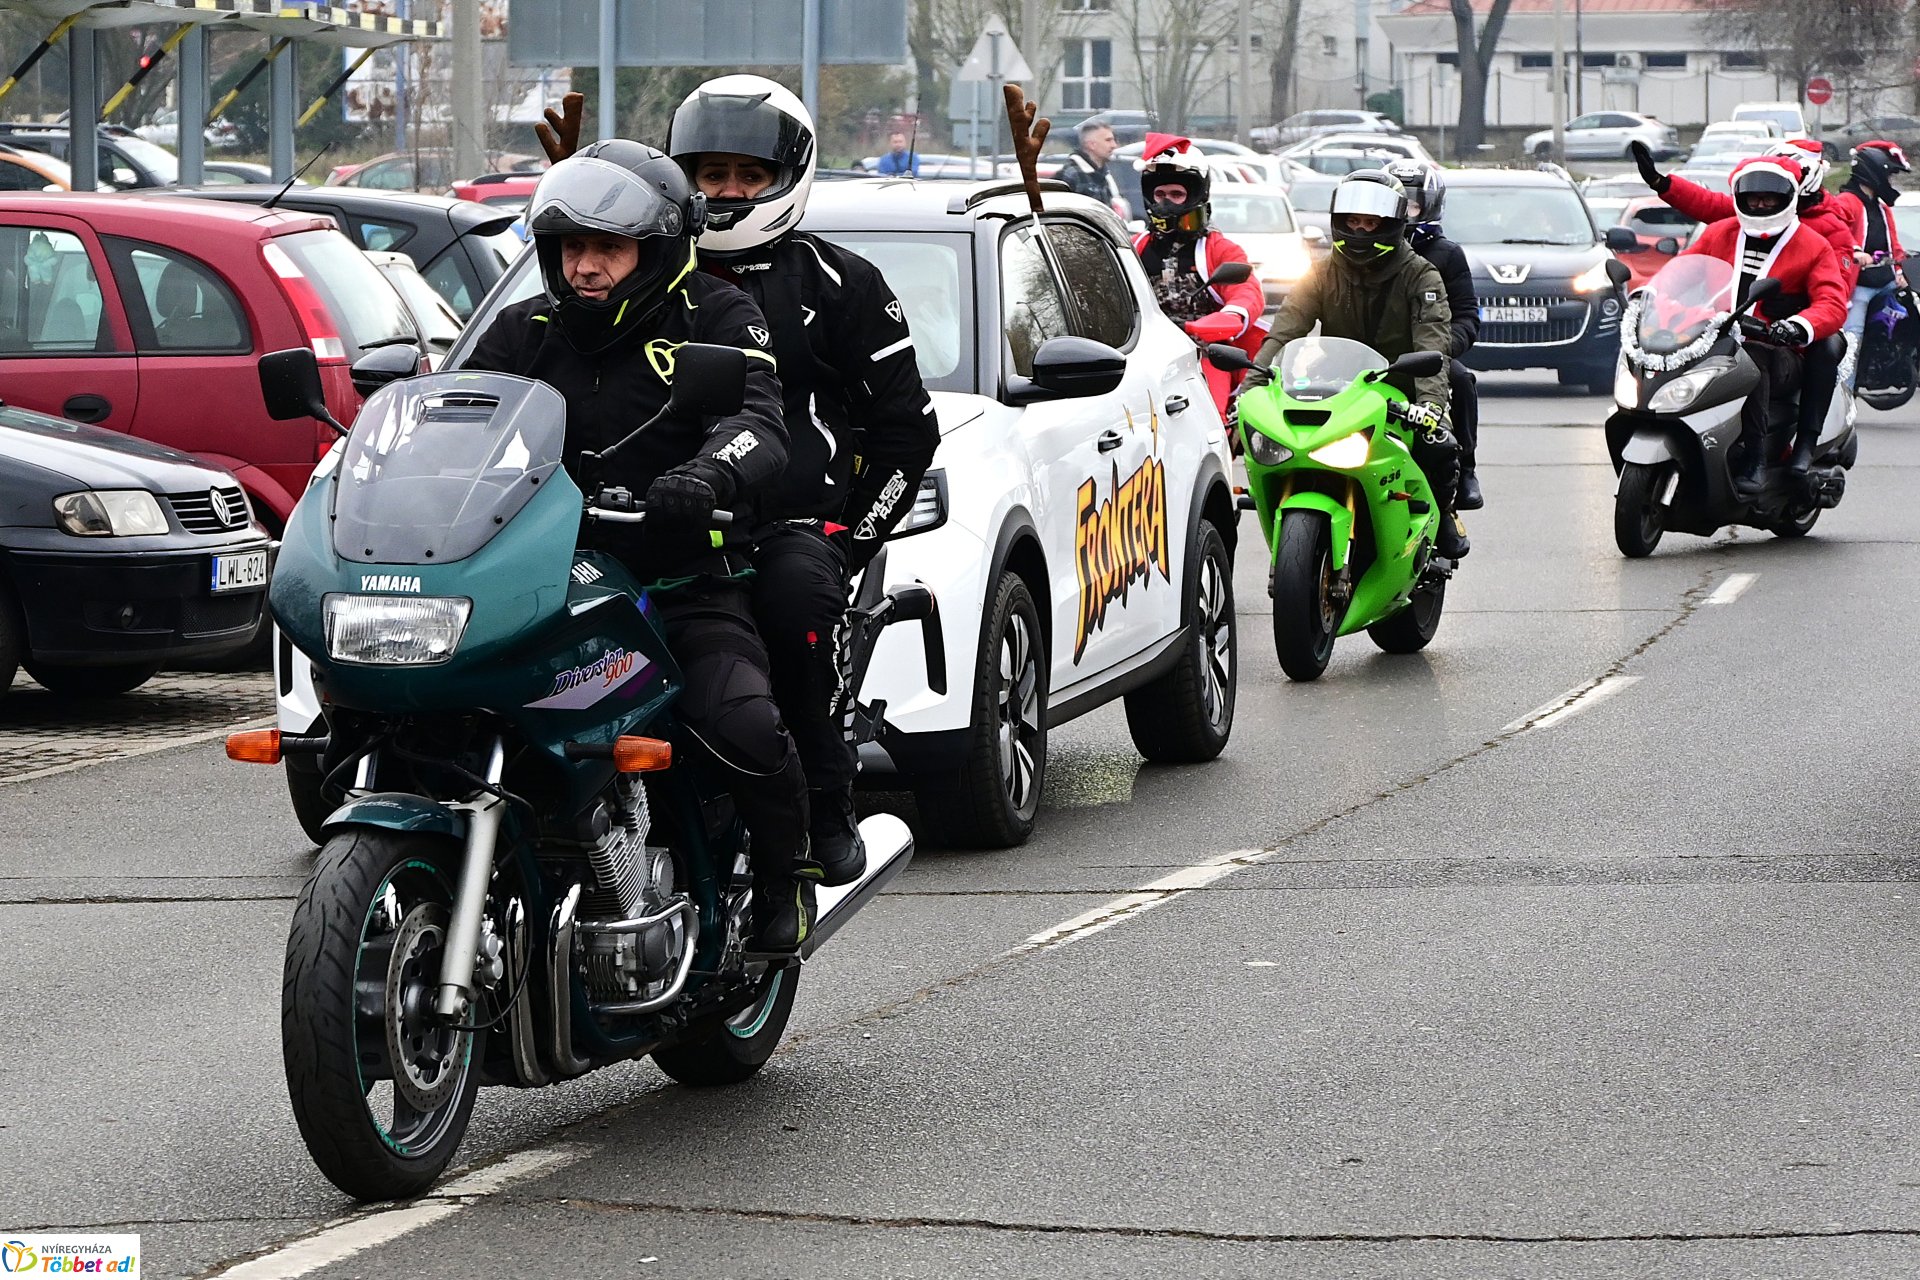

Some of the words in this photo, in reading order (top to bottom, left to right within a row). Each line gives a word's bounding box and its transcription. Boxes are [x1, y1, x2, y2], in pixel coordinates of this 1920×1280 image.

[1485, 308, 1545, 321] TAH-162
[733, 435, 760, 460] RACE
[1379, 468, 1402, 487] 636
[867, 468, 904, 522] MUGEN
[879, 478, 908, 520] RACE
[1073, 454, 1171, 657] FRONTERA
[219, 555, 265, 586] LWL-824
[360, 574, 421, 593] YAMAHA
[571, 561, 604, 585] AHA
[547, 648, 624, 698] Diversion
[602, 652, 633, 688] 900
